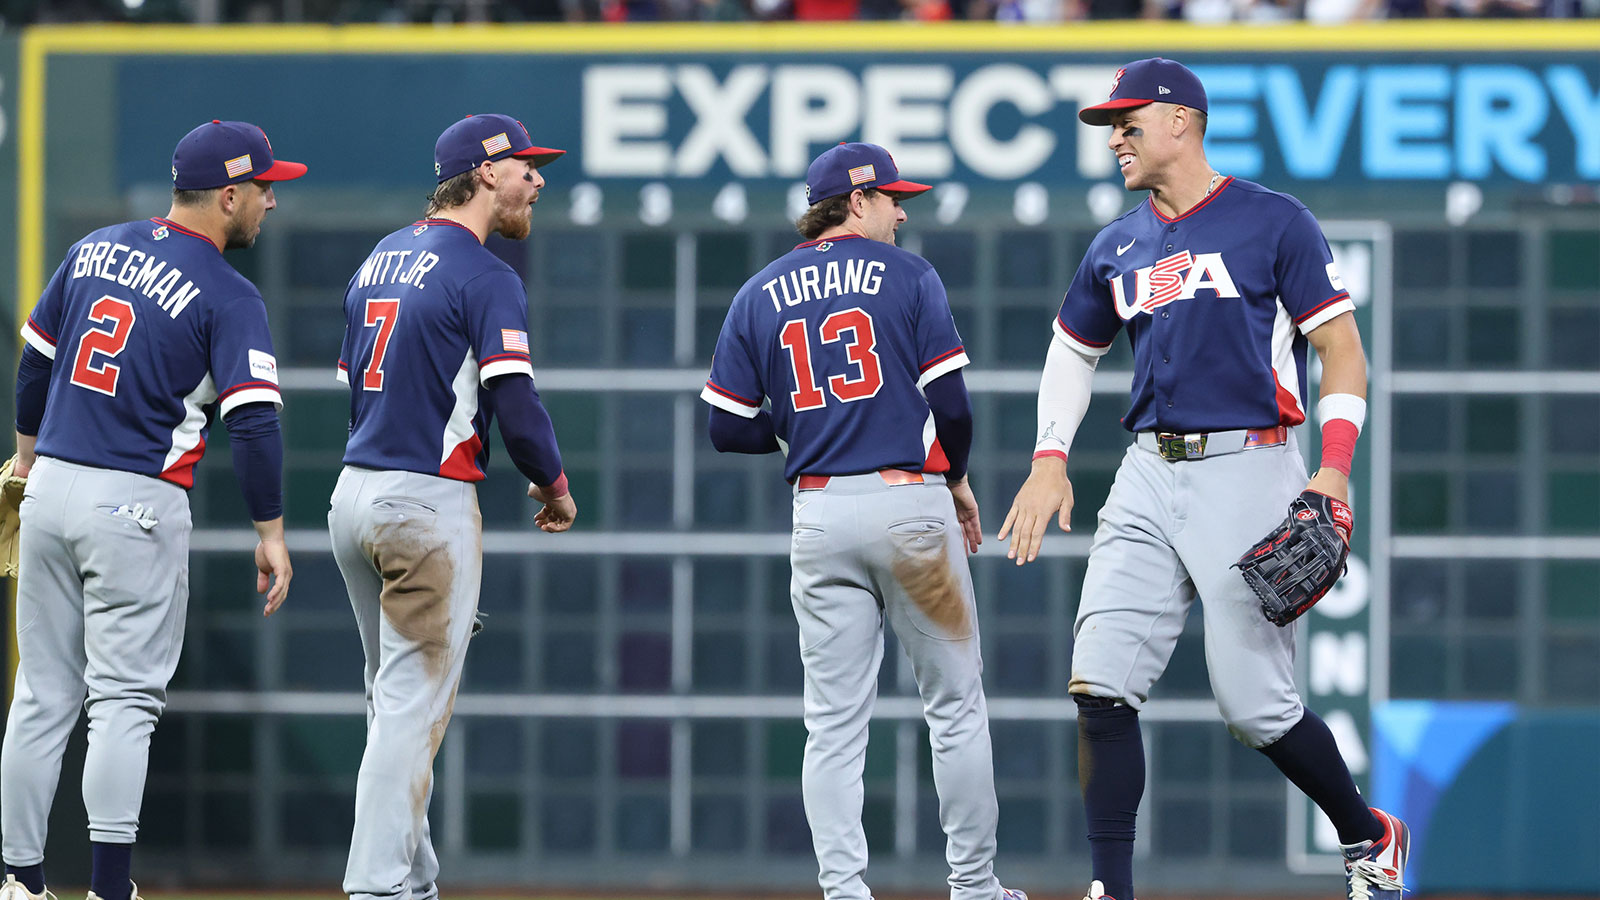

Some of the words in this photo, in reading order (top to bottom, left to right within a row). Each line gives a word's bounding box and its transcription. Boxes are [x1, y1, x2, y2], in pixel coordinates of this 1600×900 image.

[581, 64, 1124, 179] EXPECT
[73, 241, 200, 320] BREGMAN
[358, 250, 413, 288] WITT
[762, 258, 886, 313] TURANG
[1109, 249, 1241, 320] USA
[70, 294, 137, 397] 2
[363, 298, 401, 392] 7
[779, 306, 884, 412] 13
